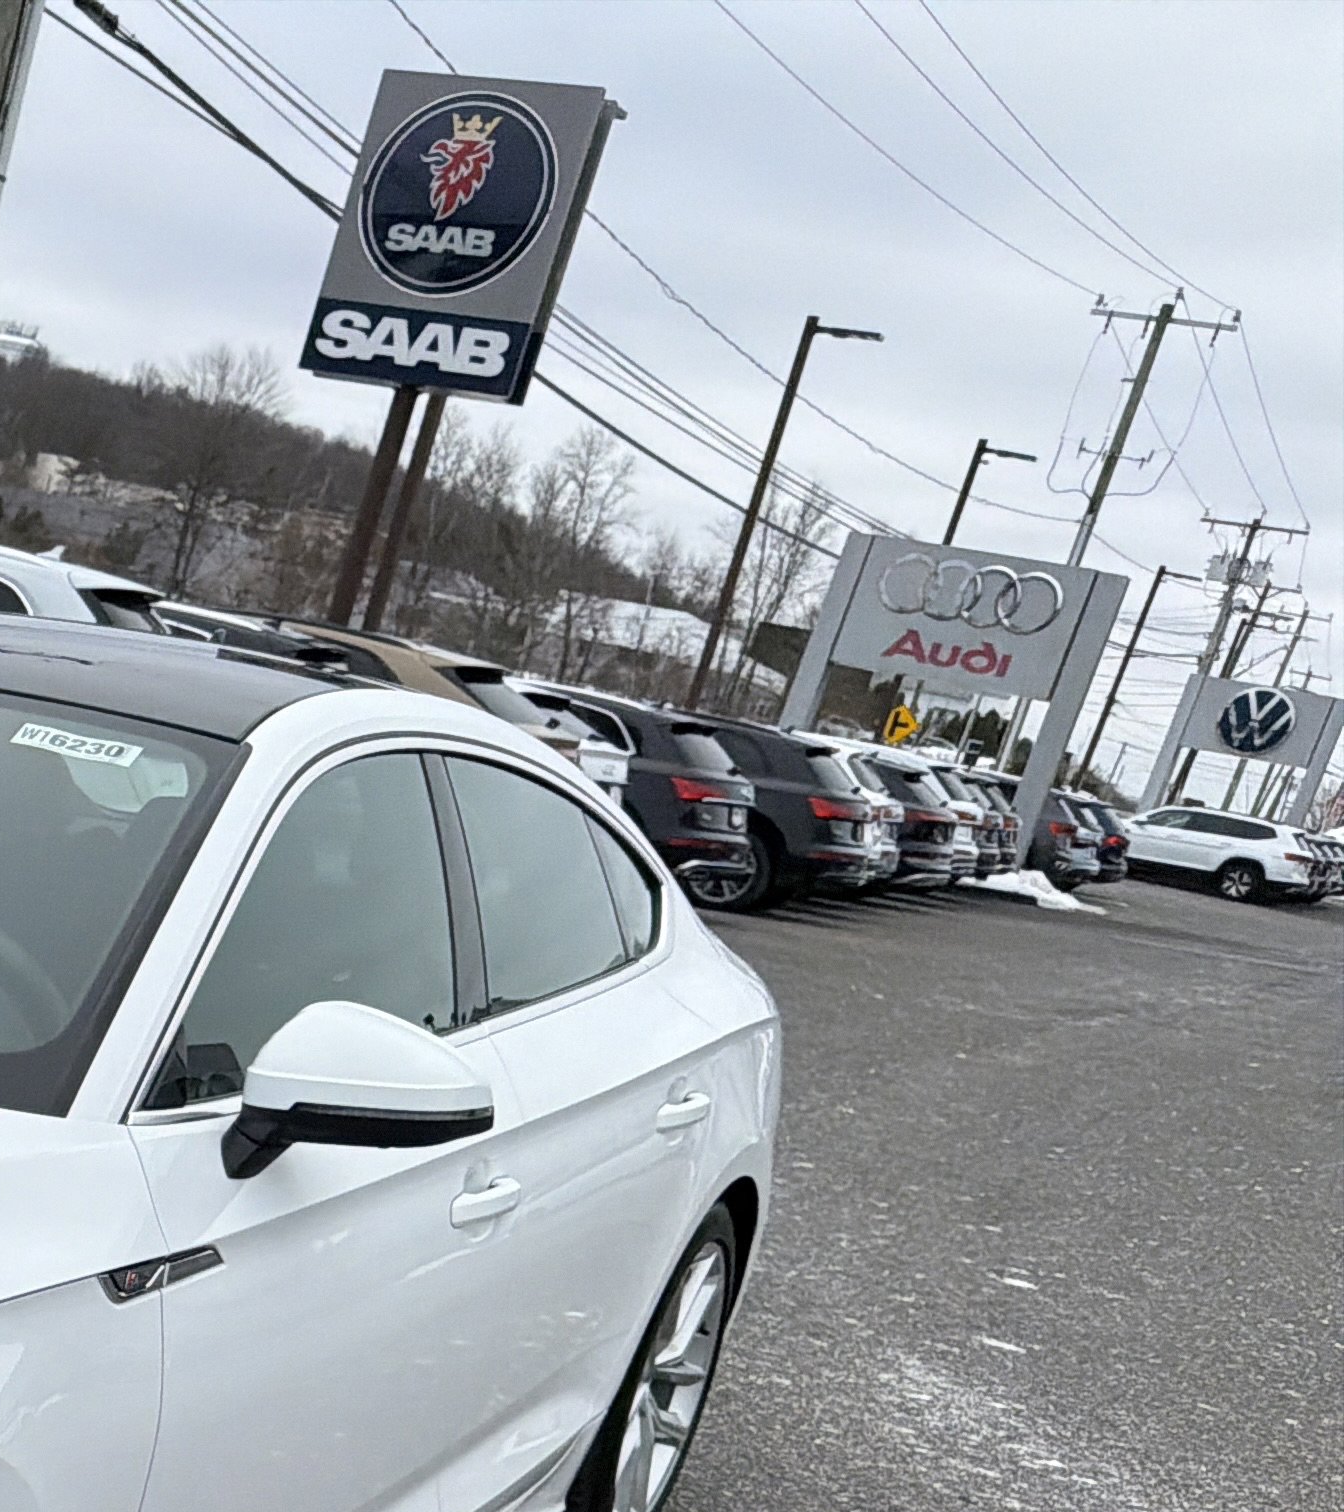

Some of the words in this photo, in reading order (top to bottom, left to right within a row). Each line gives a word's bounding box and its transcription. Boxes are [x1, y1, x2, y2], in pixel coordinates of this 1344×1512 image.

[385, 223, 496, 257] SAAB
[315, 309, 511, 379] SAAB
[880, 628, 1013, 678] Audi
[20, 726, 125, 758] W16230
